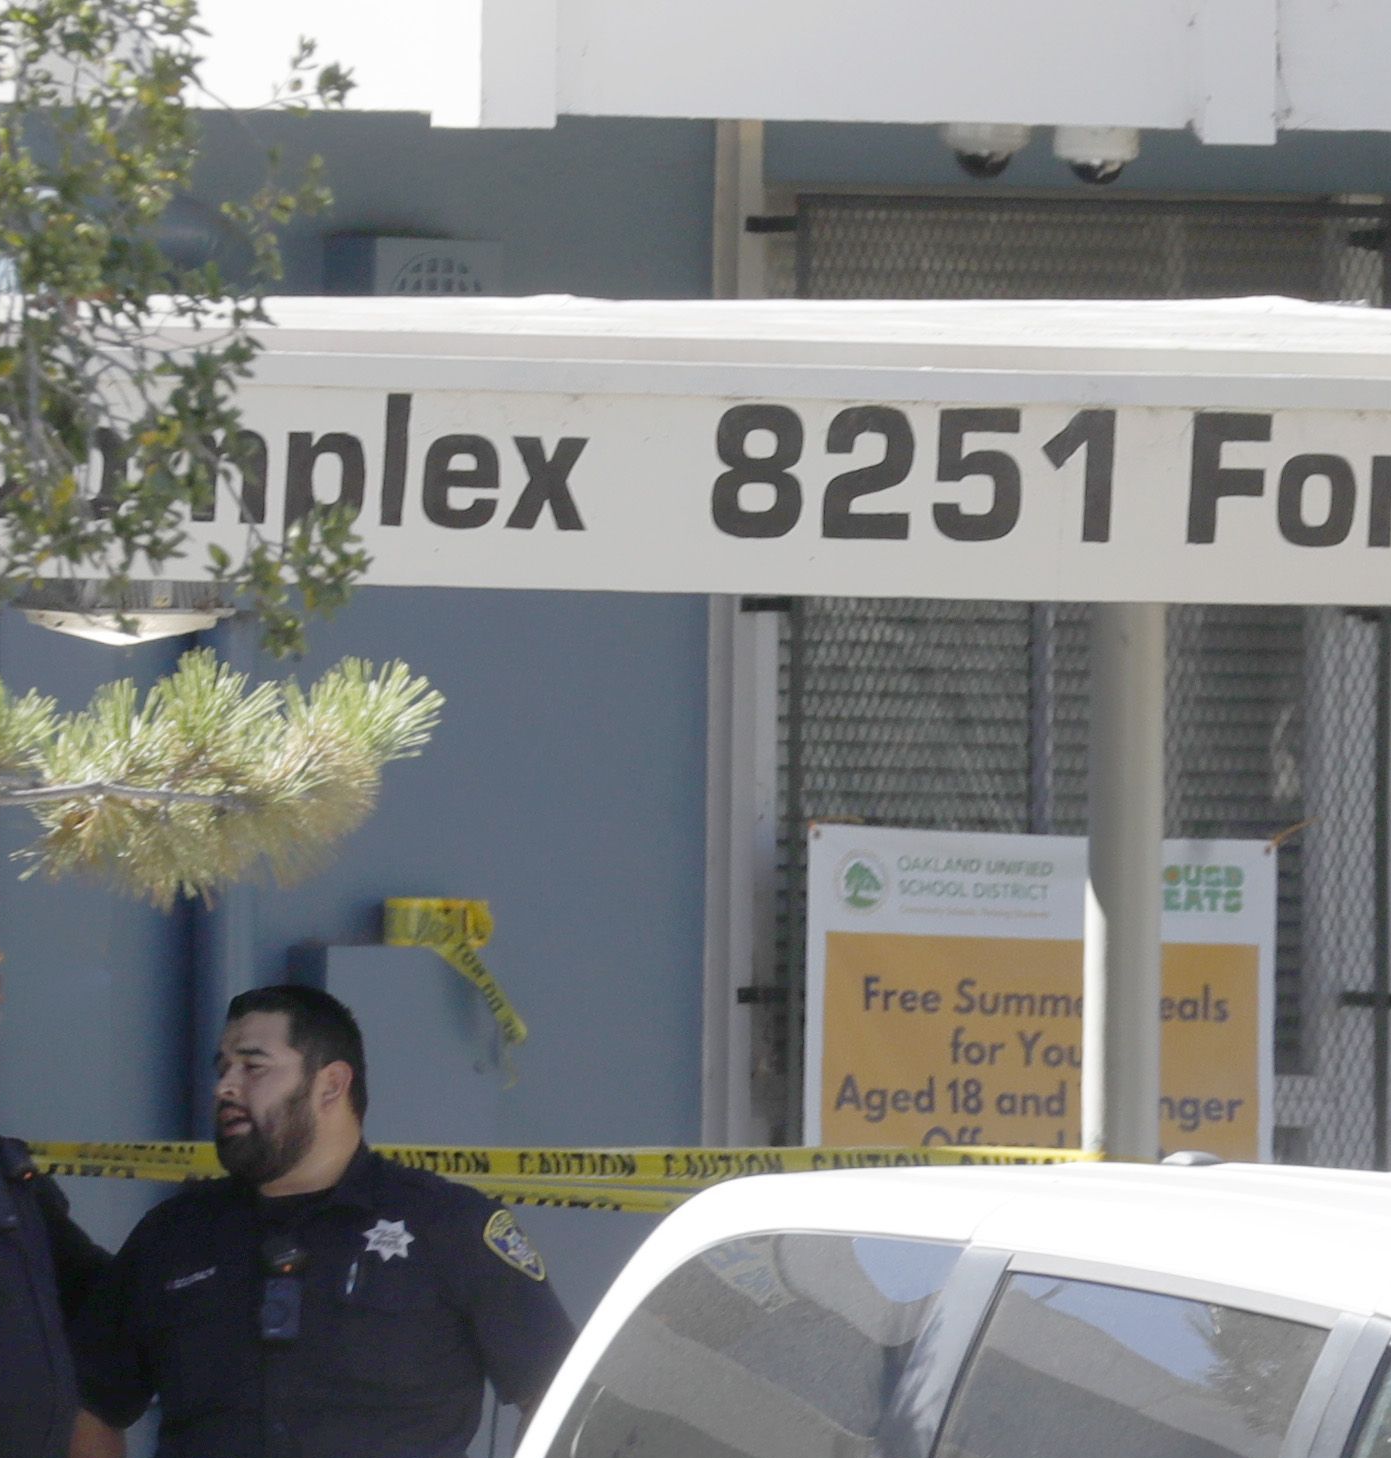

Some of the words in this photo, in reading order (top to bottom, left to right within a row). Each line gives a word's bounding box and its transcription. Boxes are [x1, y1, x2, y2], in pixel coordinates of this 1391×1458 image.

[711, 403, 1116, 544] 8251
[897, 855, 981, 874] OAKLAND
[985, 859, 1054, 877] UNIFIED
[898, 878, 967, 898] SCHOOL
[973, 882, 1049, 901] DISTRICT
[863, 975, 942, 1013] Free
[953, 978, 1083, 1018] Summ
[1160, 983, 1230, 1023] eals
[952, 1025, 1005, 1066] for
[1018, 1030, 1083, 1068] You
[835, 1073, 936, 1124] Aged
[947, 1077, 983, 1115] 18
[995, 1079, 1067, 1117] and
[1160, 1095, 1244, 1133] nger
[517, 1152, 637, 1176] CAUTION
[663, 1153, 785, 1179] CAUTION
